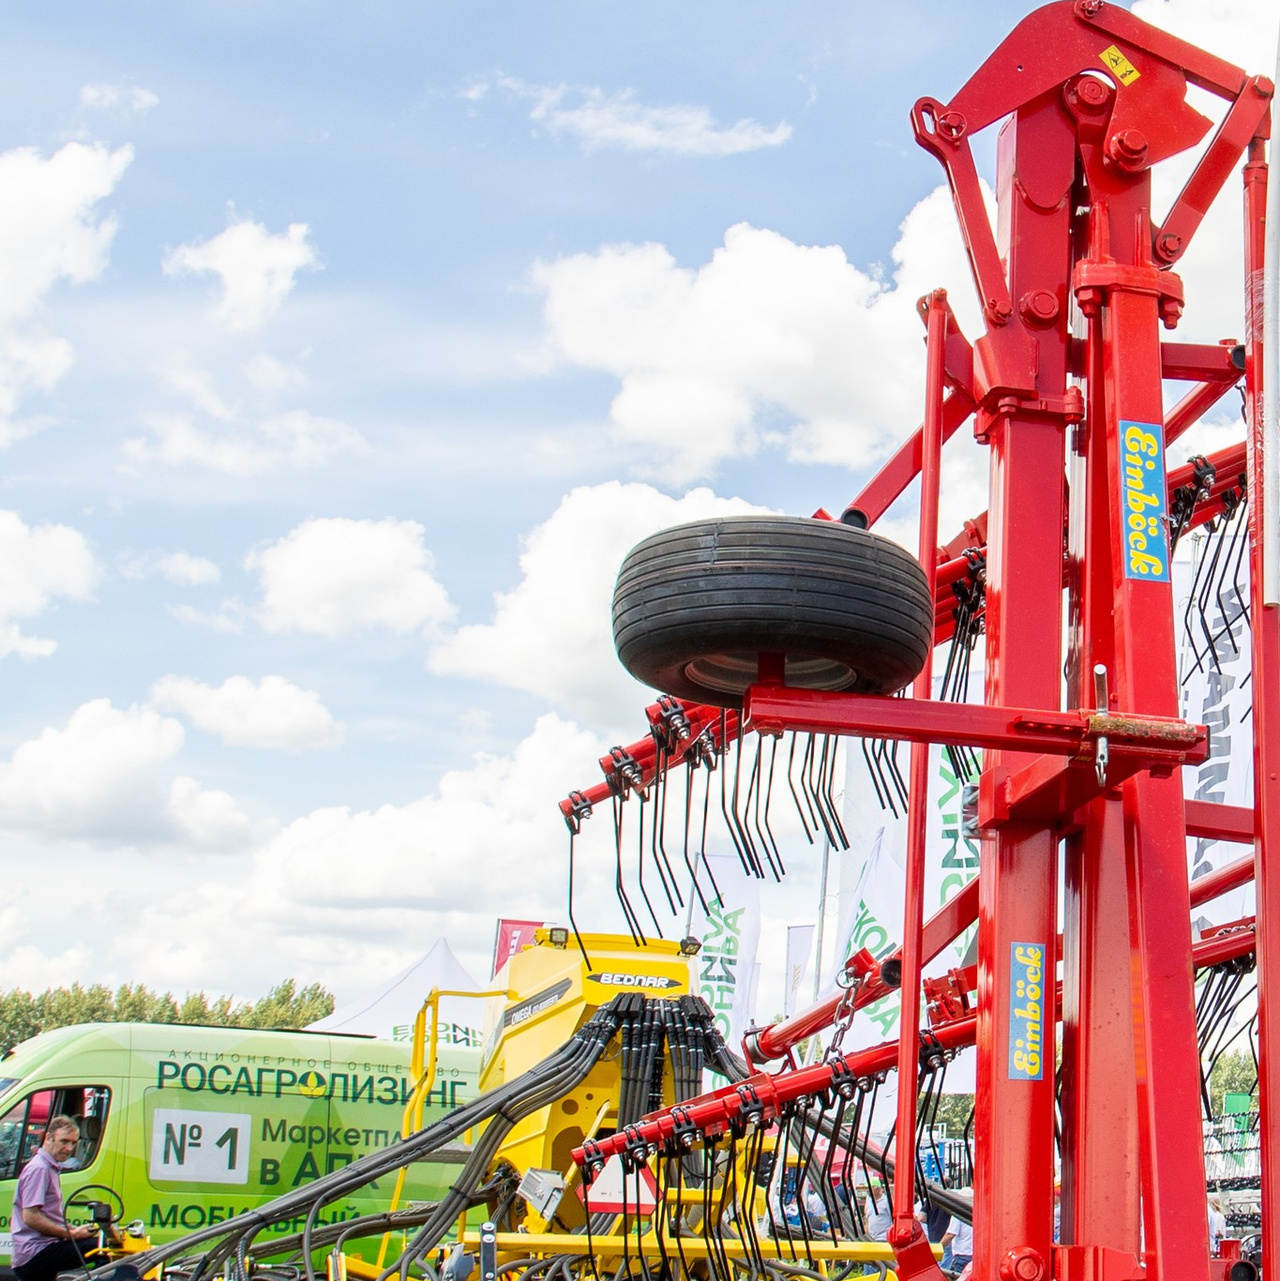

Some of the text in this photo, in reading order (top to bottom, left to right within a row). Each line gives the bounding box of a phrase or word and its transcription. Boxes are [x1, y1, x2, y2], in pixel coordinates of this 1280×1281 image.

[1125, 423, 1164, 577] Einböck
[600, 972, 669, 989] BEDNAR
[1014, 945, 1044, 1079] Einböck
[168, 1049, 460, 1077] АКЦИОНЕРНОЕ ОБЩЕВО
[216, 1127, 240, 1170] 1
